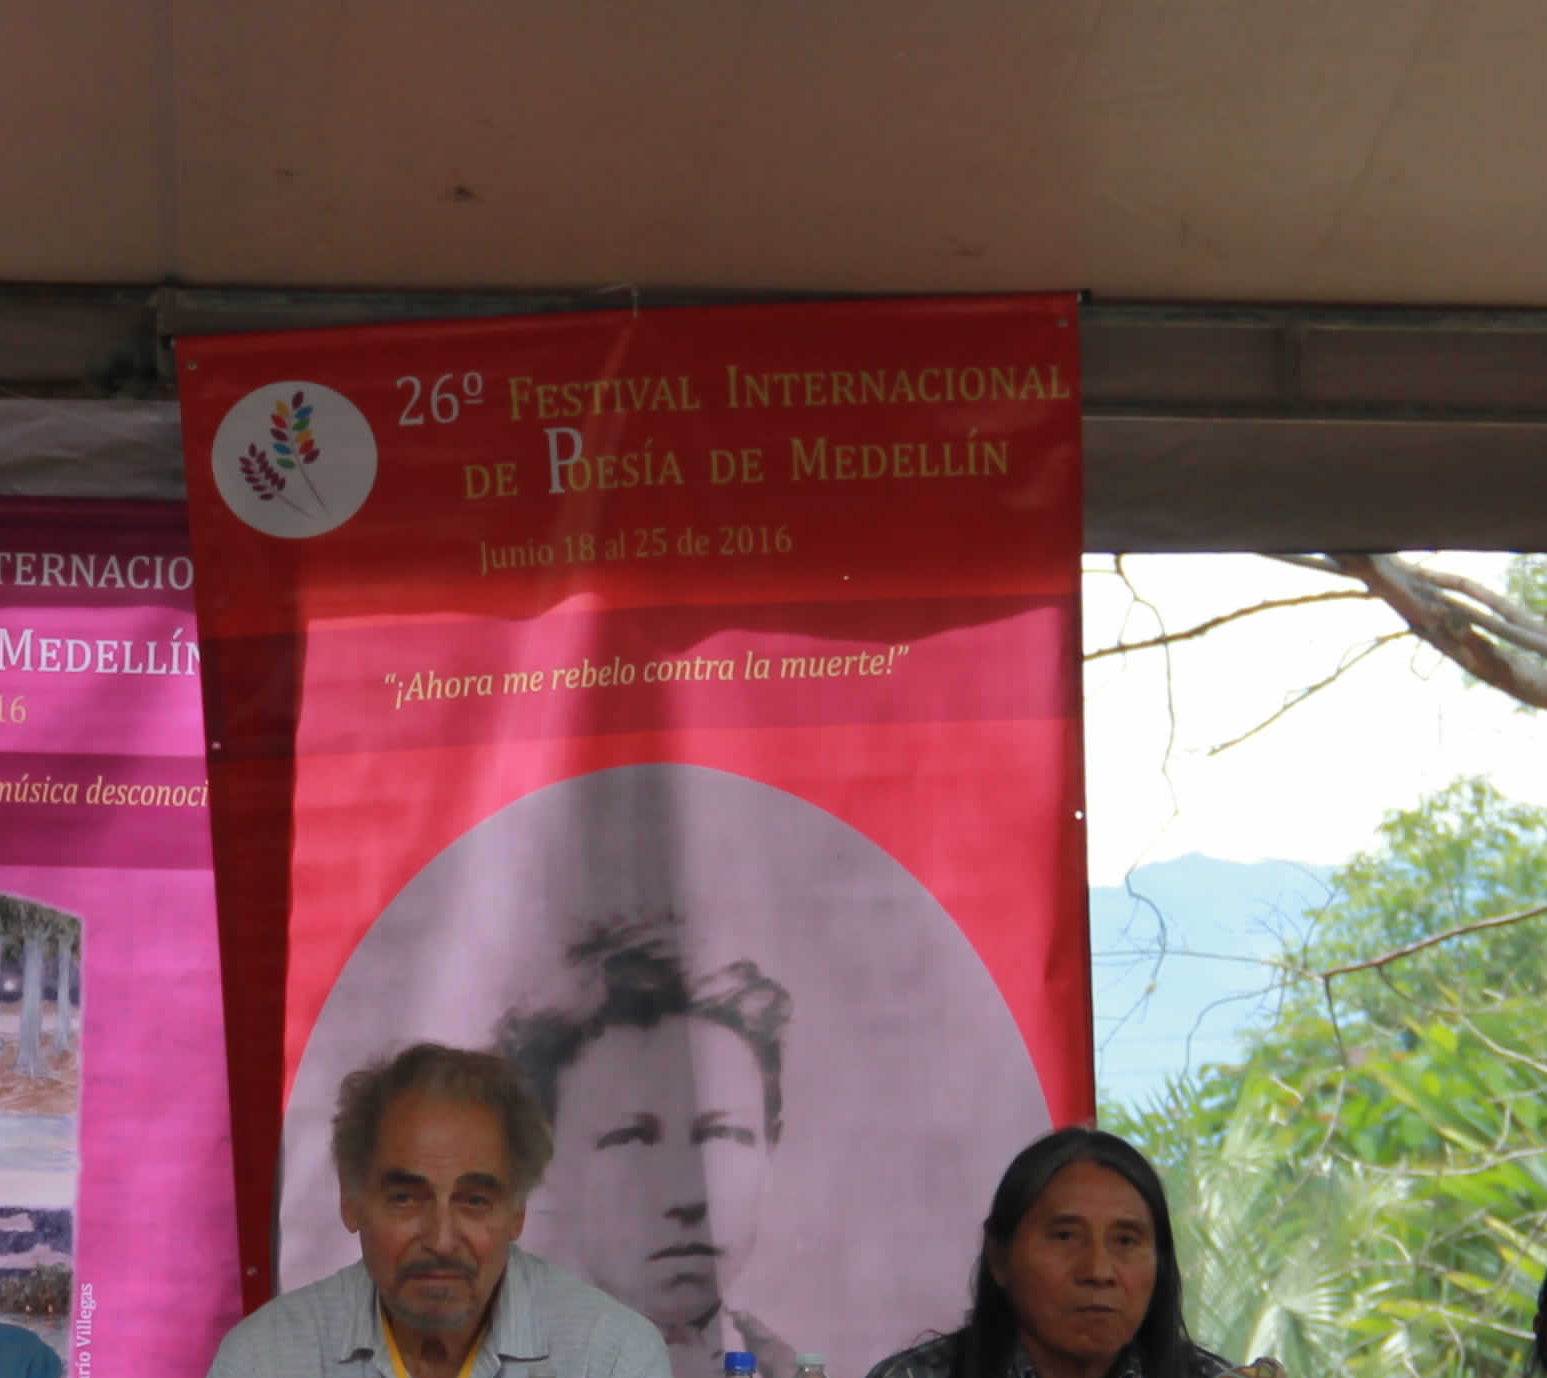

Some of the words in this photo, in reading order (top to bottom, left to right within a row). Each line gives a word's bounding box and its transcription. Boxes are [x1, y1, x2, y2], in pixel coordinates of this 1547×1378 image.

[508, 376, 702, 421] FESTIVAL
[726, 364, 1070, 409] INTERNACIONAL
[463, 463, 518, 500] DE
[543, 427, 685, 494] POESÍA
[709, 448, 765, 485] DE
[789, 427, 1008, 482] MEDELLÍN
[480, 538, 553, 577] Junio
[565, 533, 595, 564] 18
[604, 531, 626, 560] al
[633, 528, 667, 558] 25
[676, 527, 710, 556] de
[719, 526, 792, 555] 2016
[502, 670, 544, 696] me
[551, 655, 635, 690] rebelo
[643, 655, 735, 683] contra
[744, 650, 771, 680] la
[75, 1283, 98, 1345] Villegas
